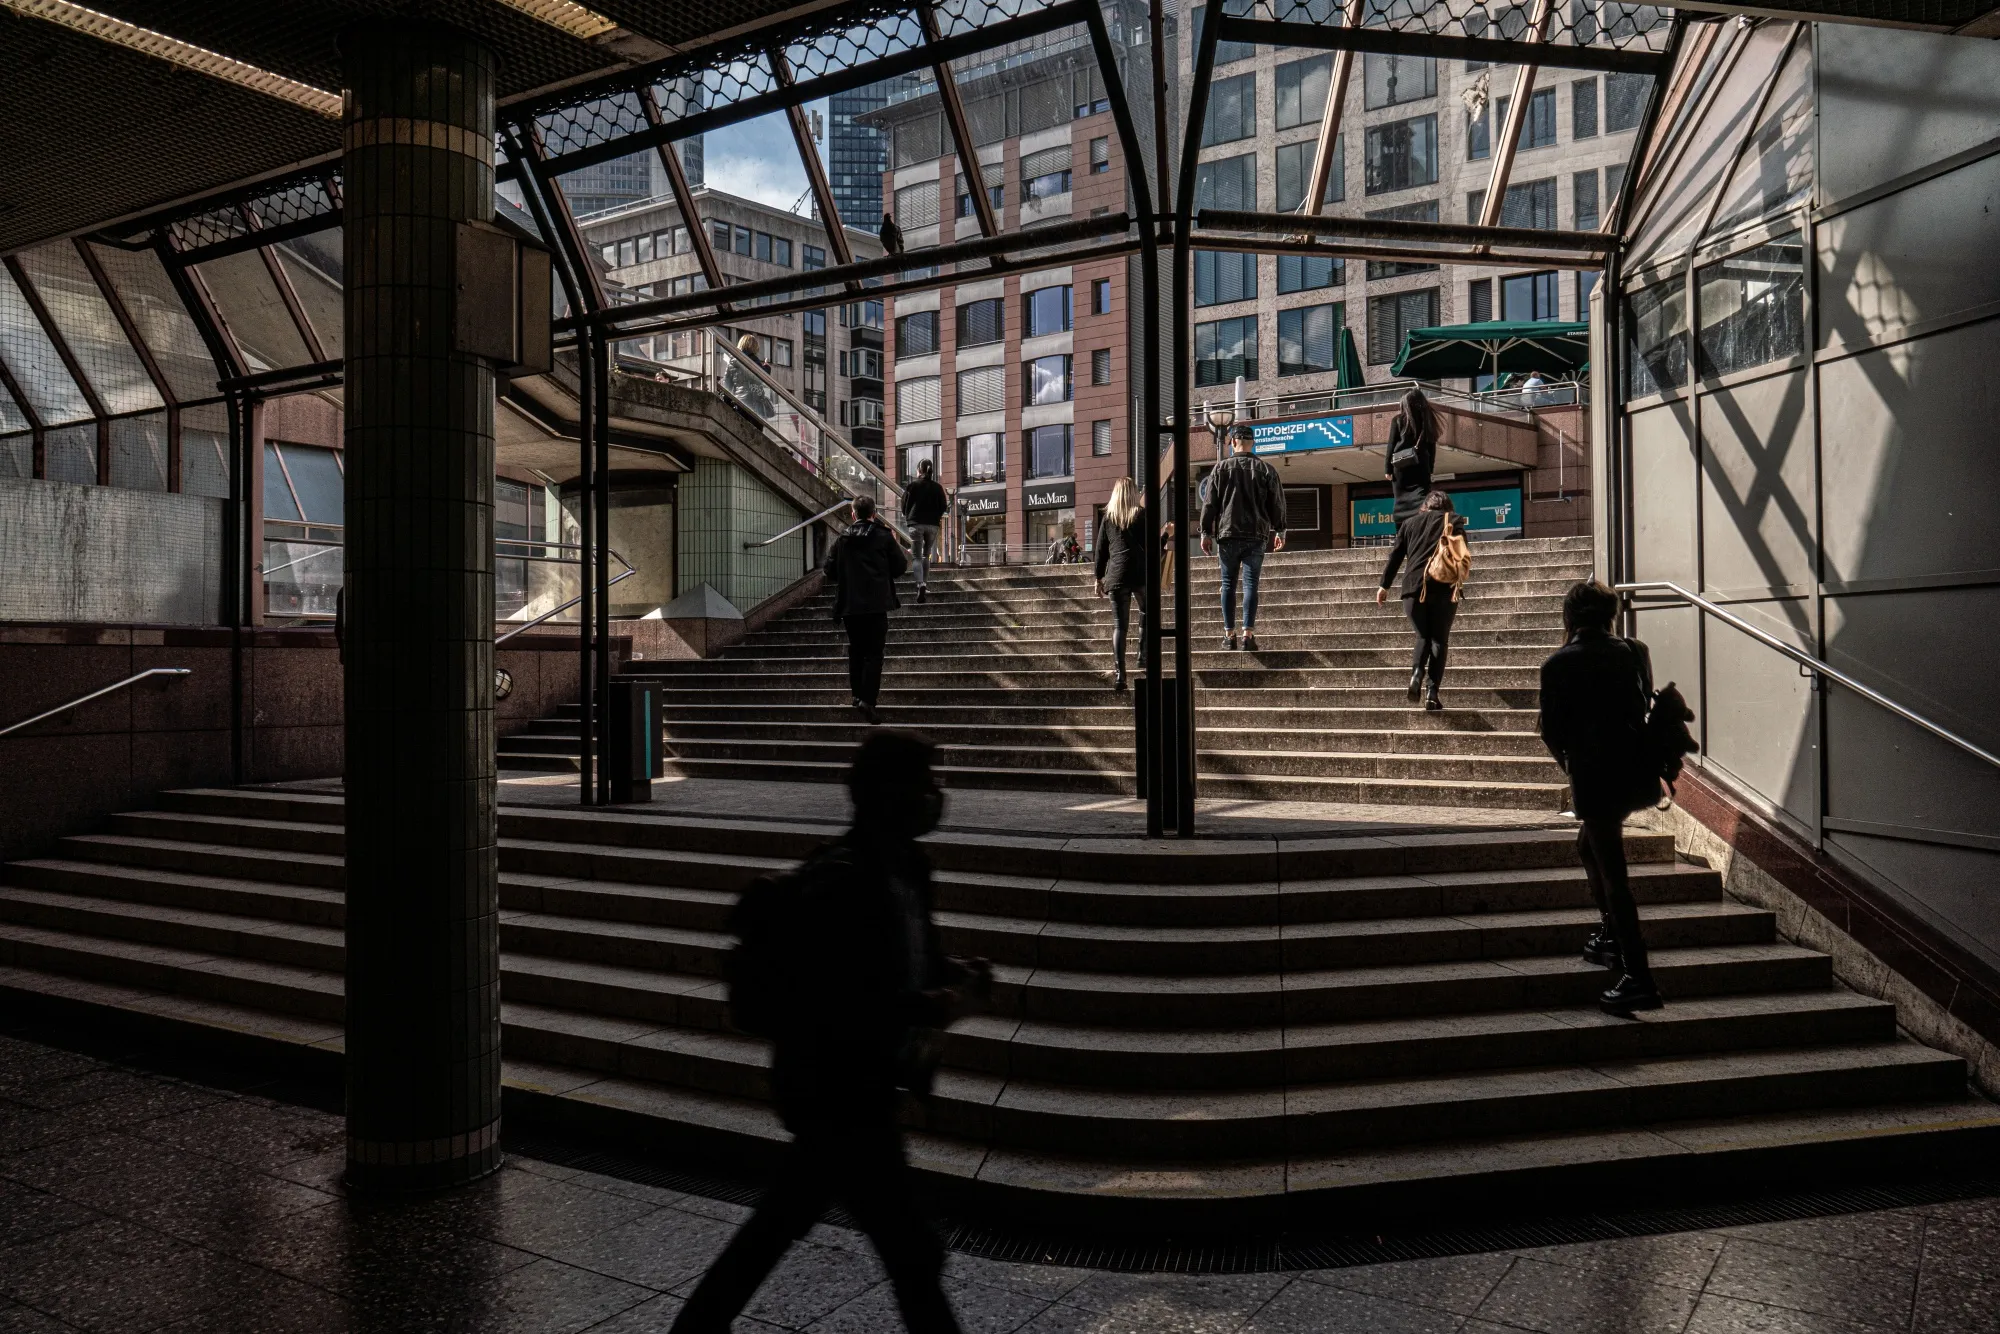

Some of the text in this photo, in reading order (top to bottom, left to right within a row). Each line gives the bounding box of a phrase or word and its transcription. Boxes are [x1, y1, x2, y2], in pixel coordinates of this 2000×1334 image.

[1254, 423, 1306, 437] DTPOLIZEI
[1254, 434, 1294, 443] enstadtwache
[1028, 492, 1067, 506] MaxMara
[1358, 511, 1395, 524] Wir bau
